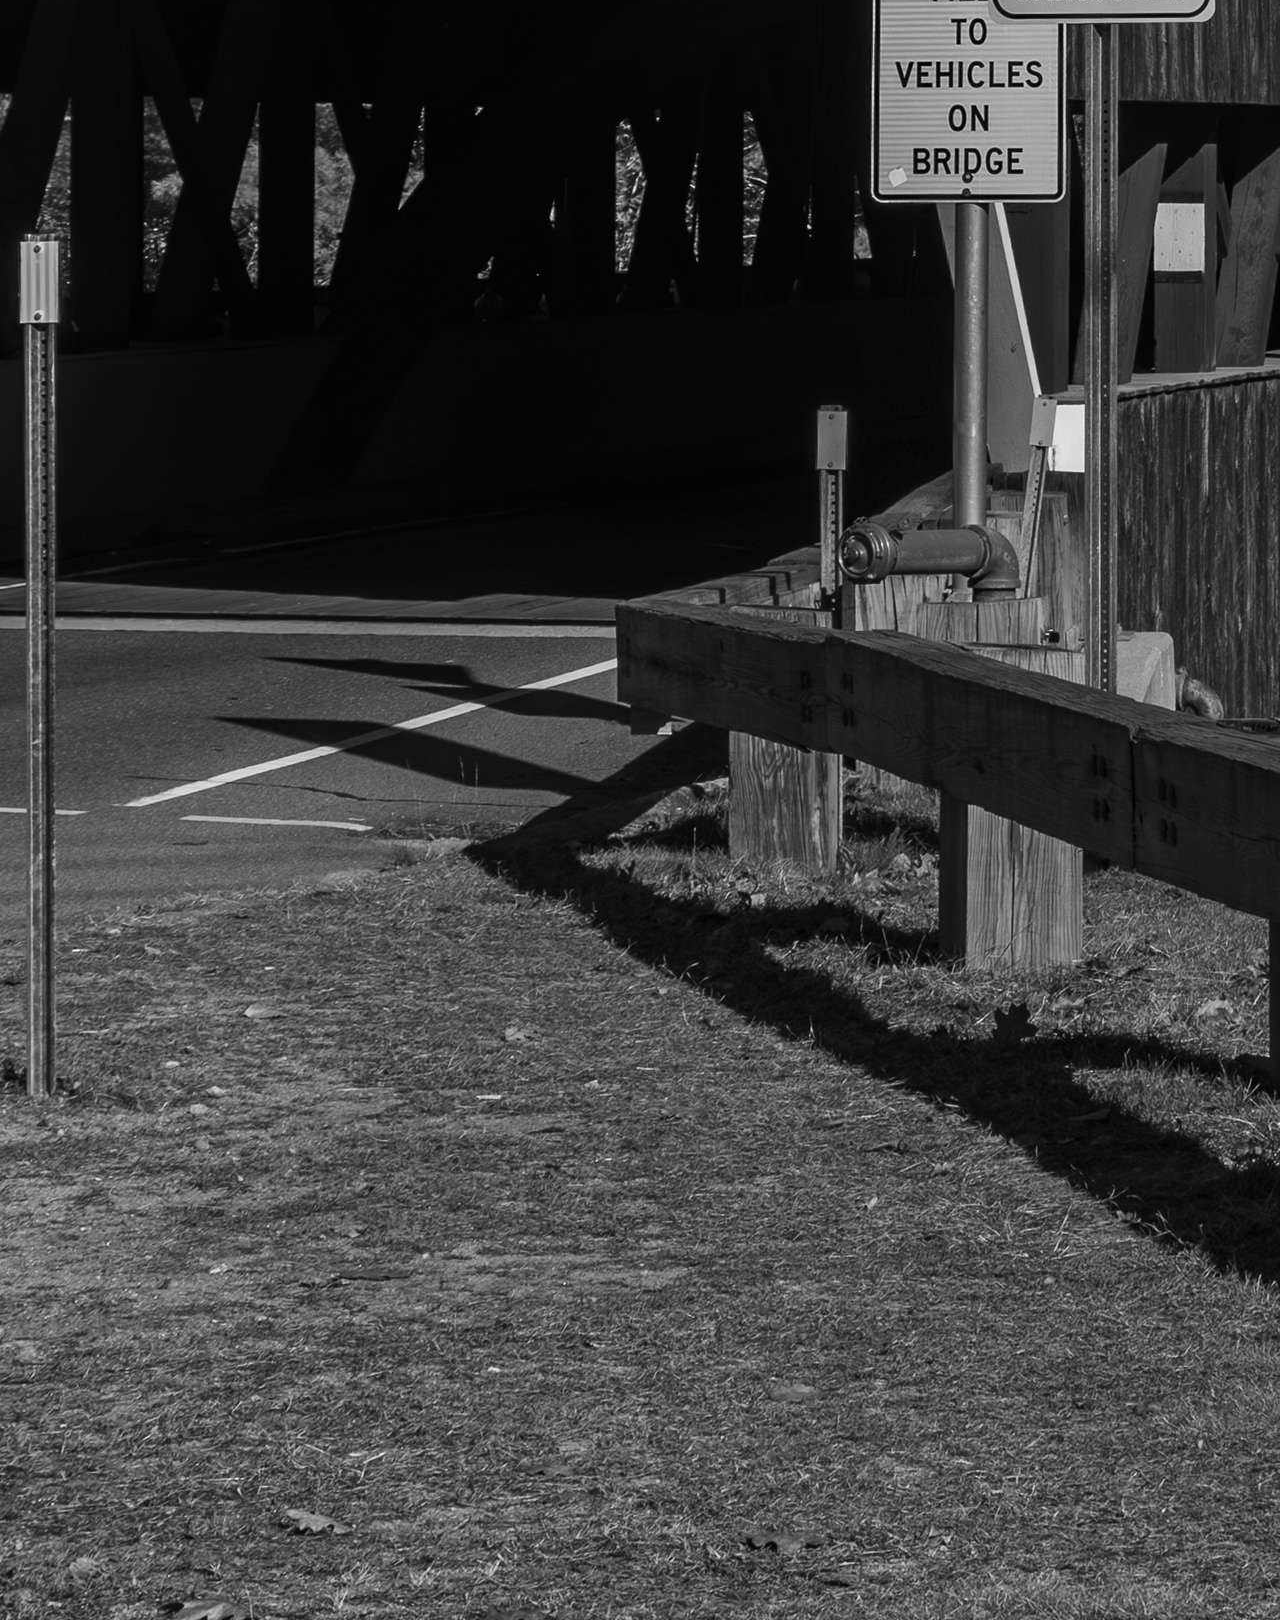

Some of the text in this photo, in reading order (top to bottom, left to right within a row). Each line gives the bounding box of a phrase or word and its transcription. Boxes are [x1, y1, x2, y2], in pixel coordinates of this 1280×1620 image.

[951, 18, 988, 45] TO
[895, 61, 1044, 88] VEHICLES
[948, 104, 990, 132] ON
[912, 147, 1024, 175] BRIDGE
